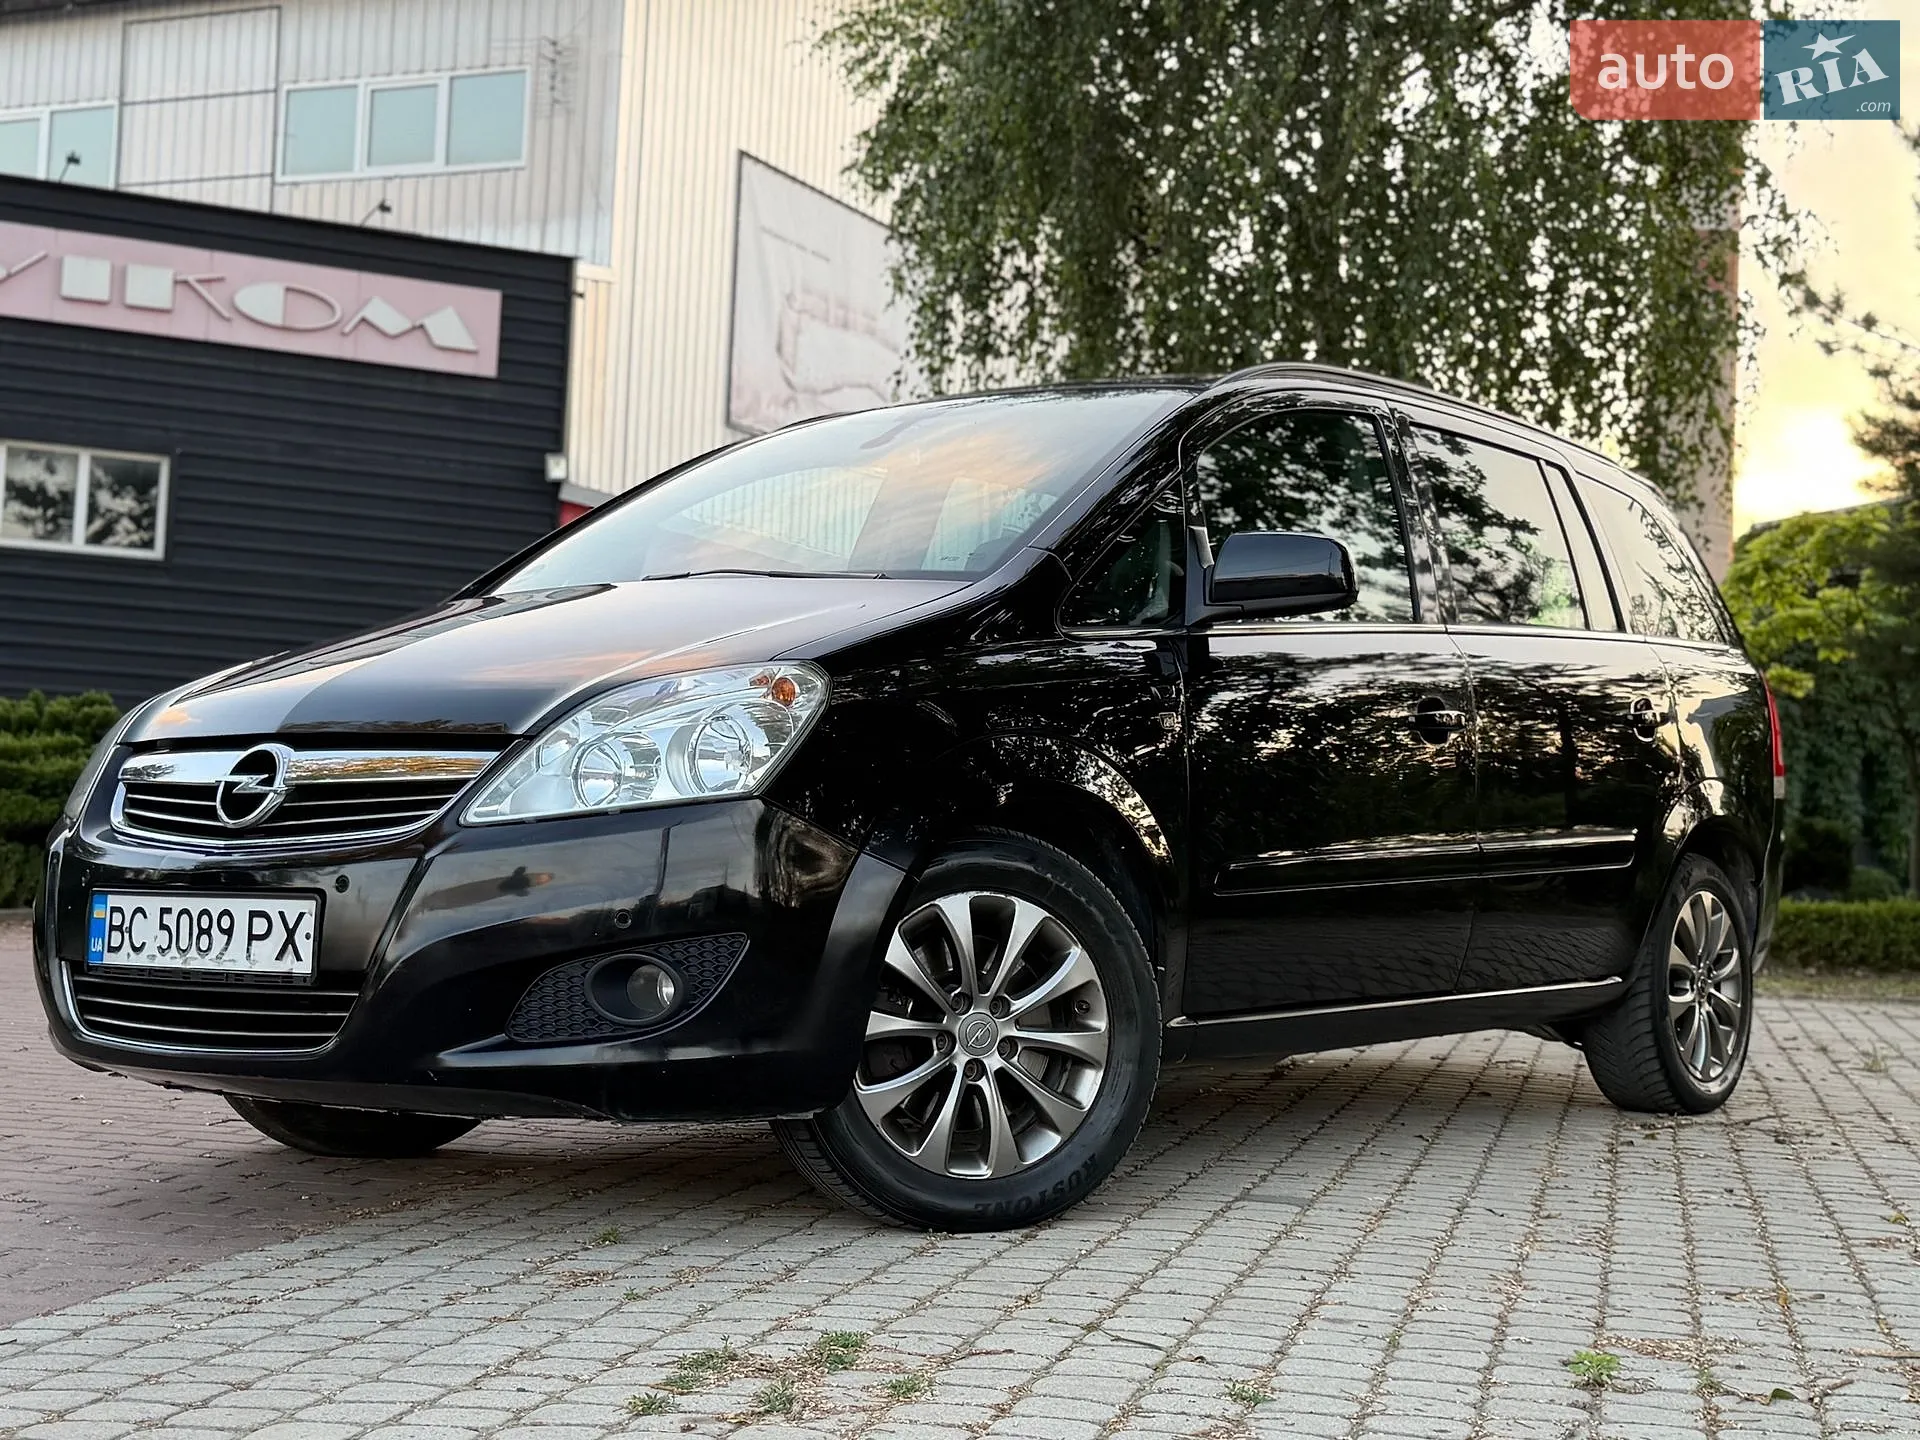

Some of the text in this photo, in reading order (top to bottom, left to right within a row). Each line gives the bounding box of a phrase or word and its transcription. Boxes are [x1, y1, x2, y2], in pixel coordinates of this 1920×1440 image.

[91, 936, 103, 953] UA
[107, 906, 306, 963] BC 5089 PX
